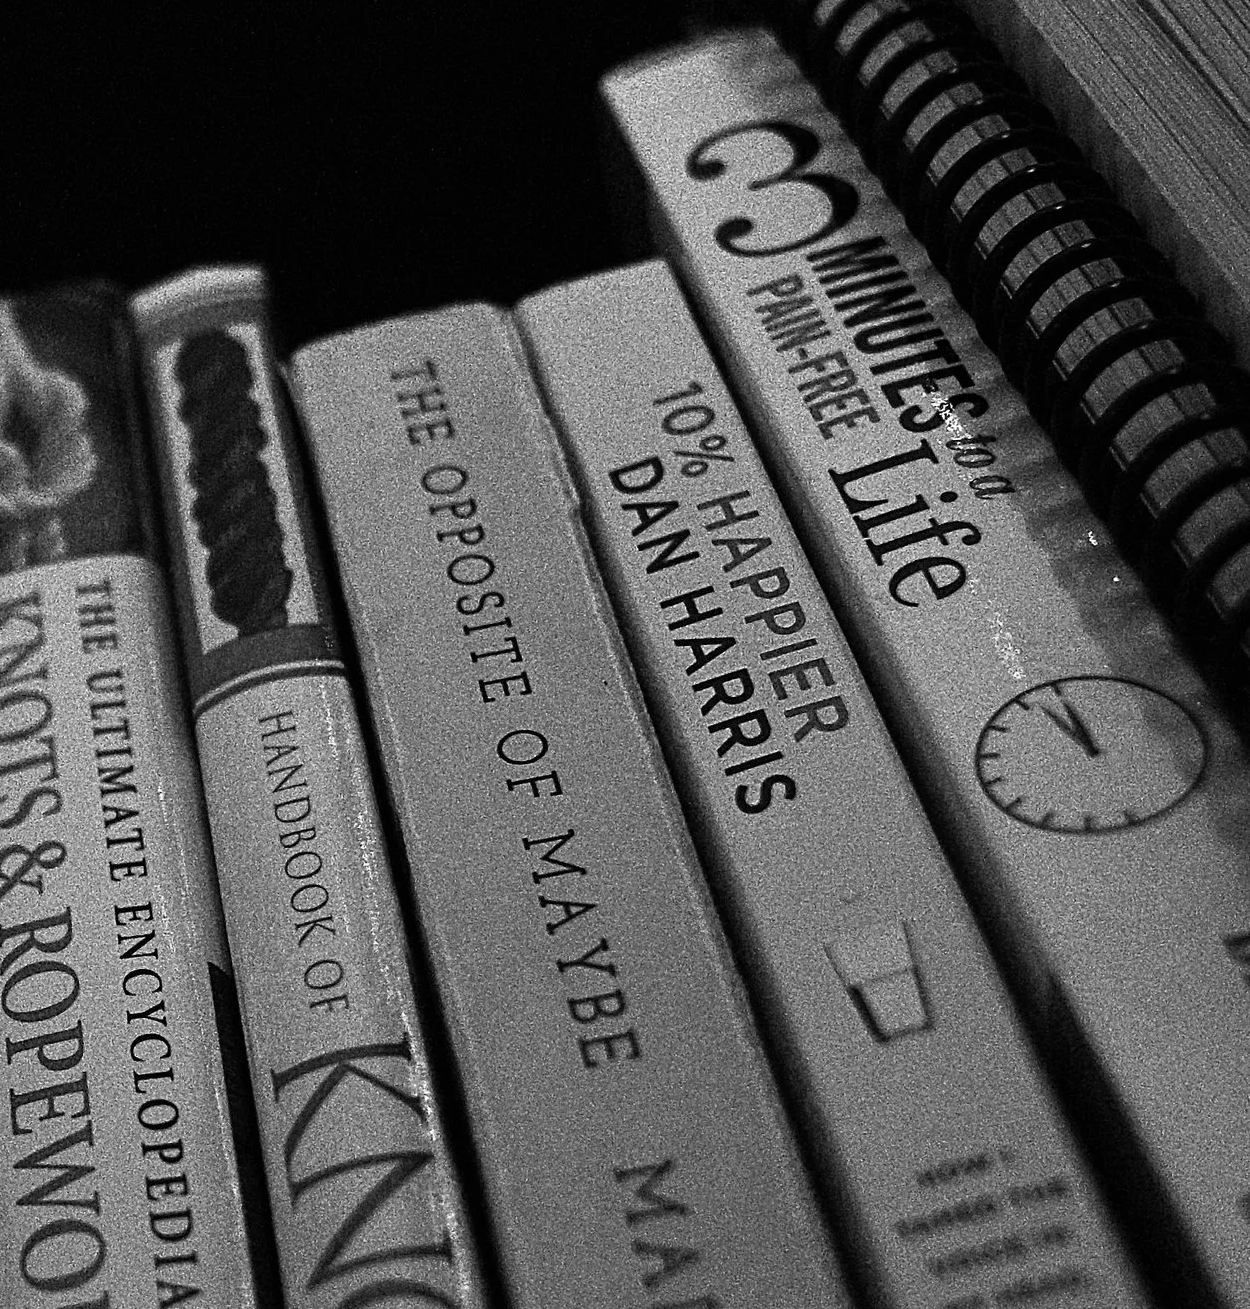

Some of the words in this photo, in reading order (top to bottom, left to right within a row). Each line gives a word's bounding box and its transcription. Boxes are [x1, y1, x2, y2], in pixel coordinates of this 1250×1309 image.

[684, 120, 860, 258] 3
[389, 360, 452, 451] THE
[751, 274, 881, 441] PAIN-FREE
[807, 236, 990, 434] MINUTES
[828, 440, 981, 610] Life
[945, 433, 997, 469] to
[968, 474, 1017, 500] a
[76, 579, 118, 656] THE
[420, 464, 533, 705] OPPOSITE
[607, 455, 700, 575] DAN
[659, 584, 798, 815] HARRIS
[652, 380, 737, 478] 10%
[696, 490, 849, 743] HAPPIER
[84, 661, 148, 883] ULTIMATE
[496, 726, 562, 803] OF
[258, 709, 336, 948] HANDBOOK
[302, 958, 349, 1015] OF
[521, 828, 639, 1069] MAYBE
[113, 900, 202, 1308] ENCYCLOPEDIA
